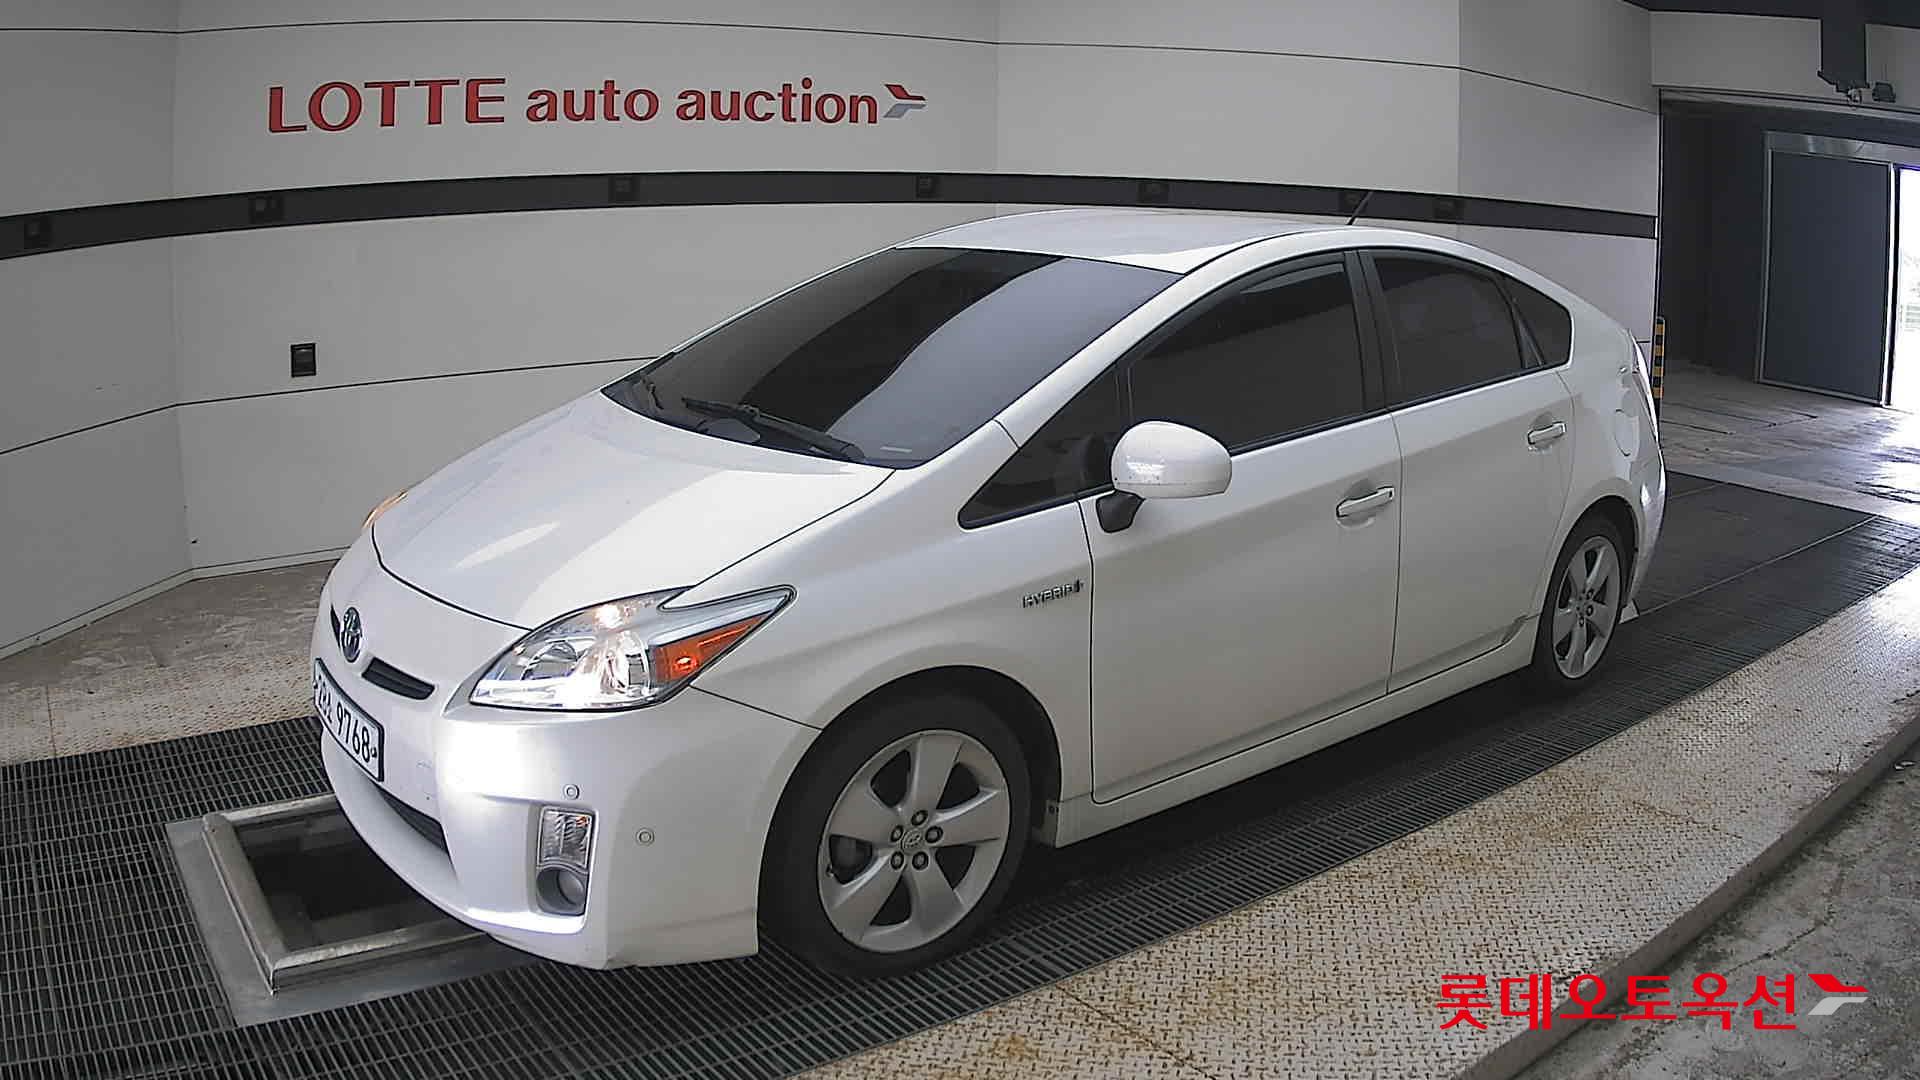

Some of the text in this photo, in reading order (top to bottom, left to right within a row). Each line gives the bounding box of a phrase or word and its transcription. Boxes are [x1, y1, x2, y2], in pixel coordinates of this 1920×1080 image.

[268, 77, 879, 133] LOTTE auto auction
[336, 701, 371, 763] 9768
